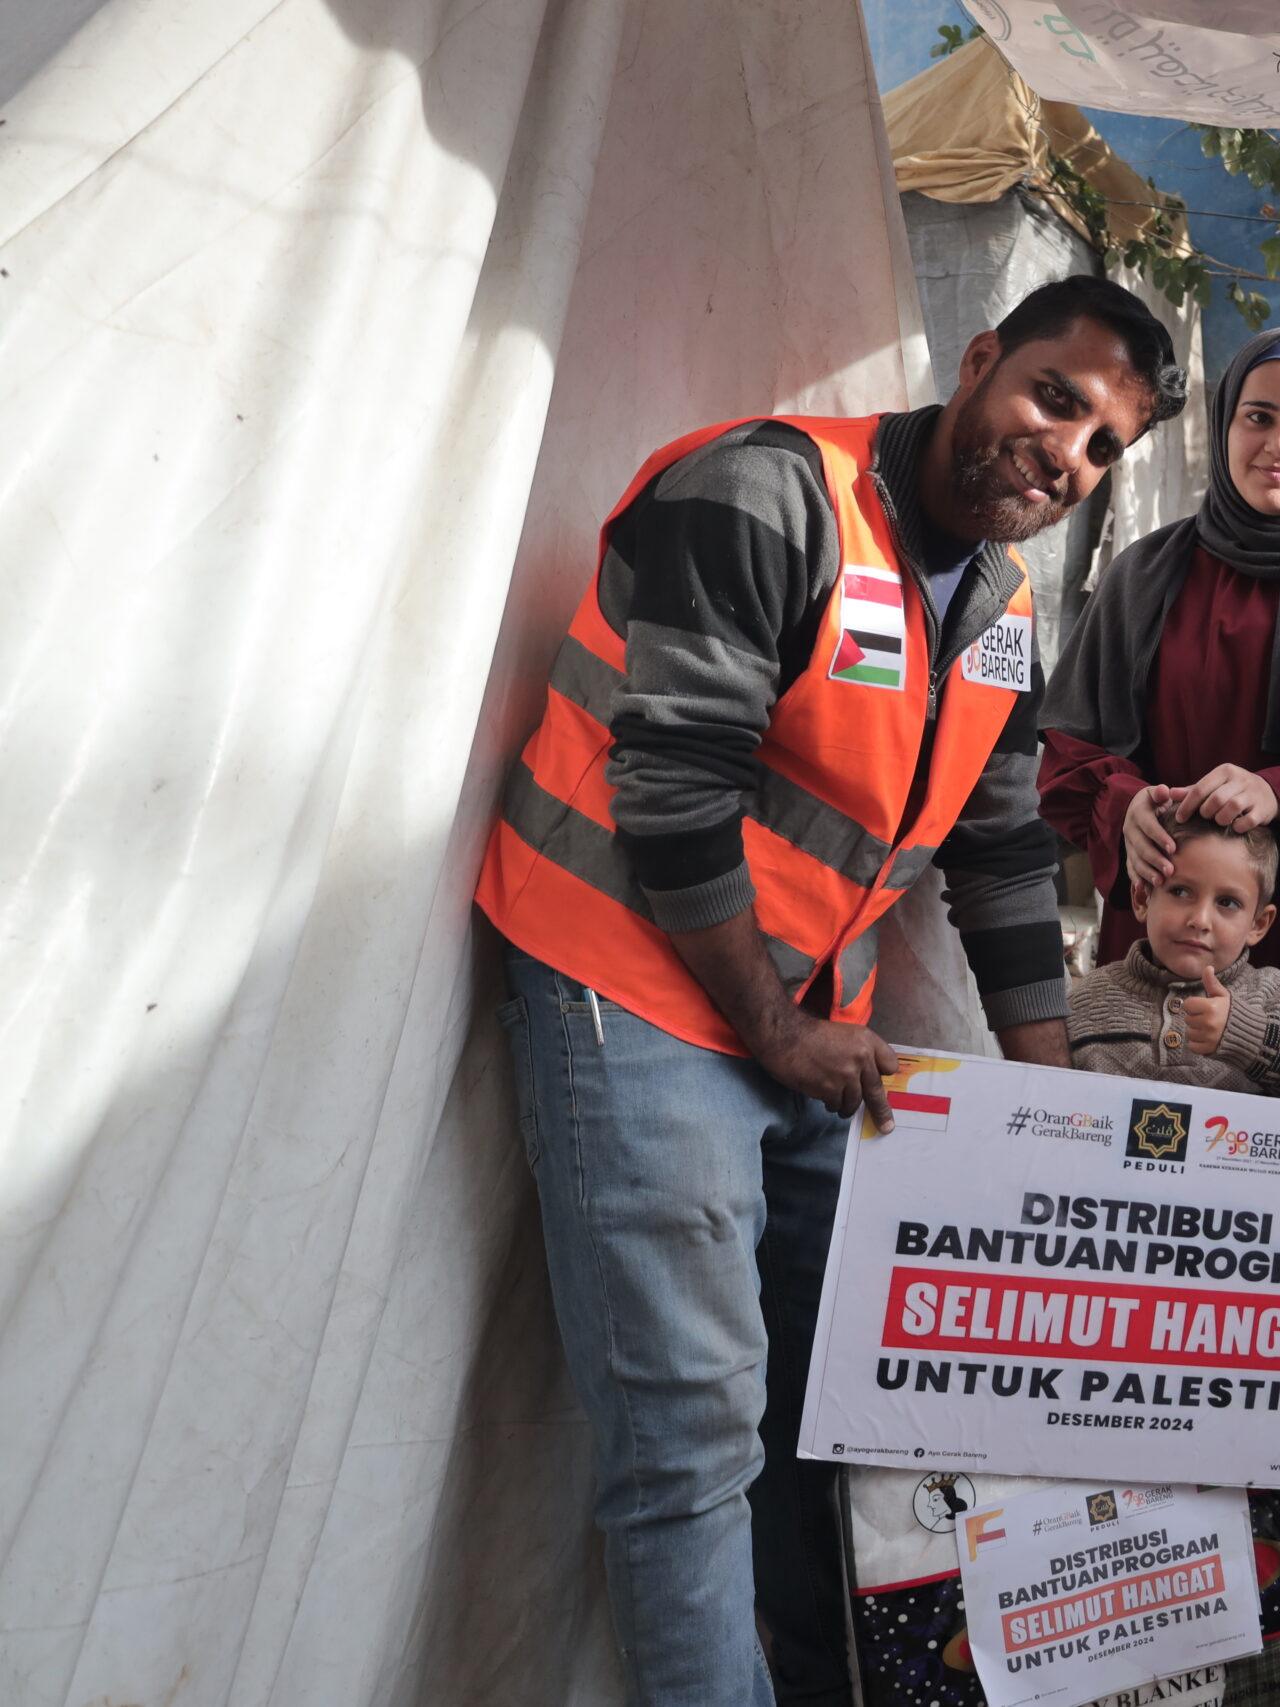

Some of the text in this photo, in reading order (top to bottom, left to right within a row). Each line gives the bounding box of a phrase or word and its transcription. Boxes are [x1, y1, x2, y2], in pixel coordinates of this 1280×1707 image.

[981, 624, 1024, 657] GERAK
[981, 654, 1024, 684] BARENG
[1032, 1124, 1113, 1146] GerakBareng
[1123, 1160, 1185, 1174] PEDULI
[1021, 1192, 1272, 1244] DISTRIBUSI
[896, 1220, 1136, 1272] BANTUAN
[901, 1282, 1139, 1349] SELIMUT
[876, 1357, 1063, 1400] UNTUK
[1047, 1412, 1194, 1432] DESEMBER 2024
[998, 1533, 1219, 1609] BANTUAN PROGRAM
[1050, 1528, 1168, 1575] DISTRIBUSI
[1010, 1563, 1216, 1645] SELIMUT HANGAT
[1007, 1597, 1228, 1673] UNTUK PALESTINA
[1088, 1636, 1154, 1663] DESEMBER 2024
